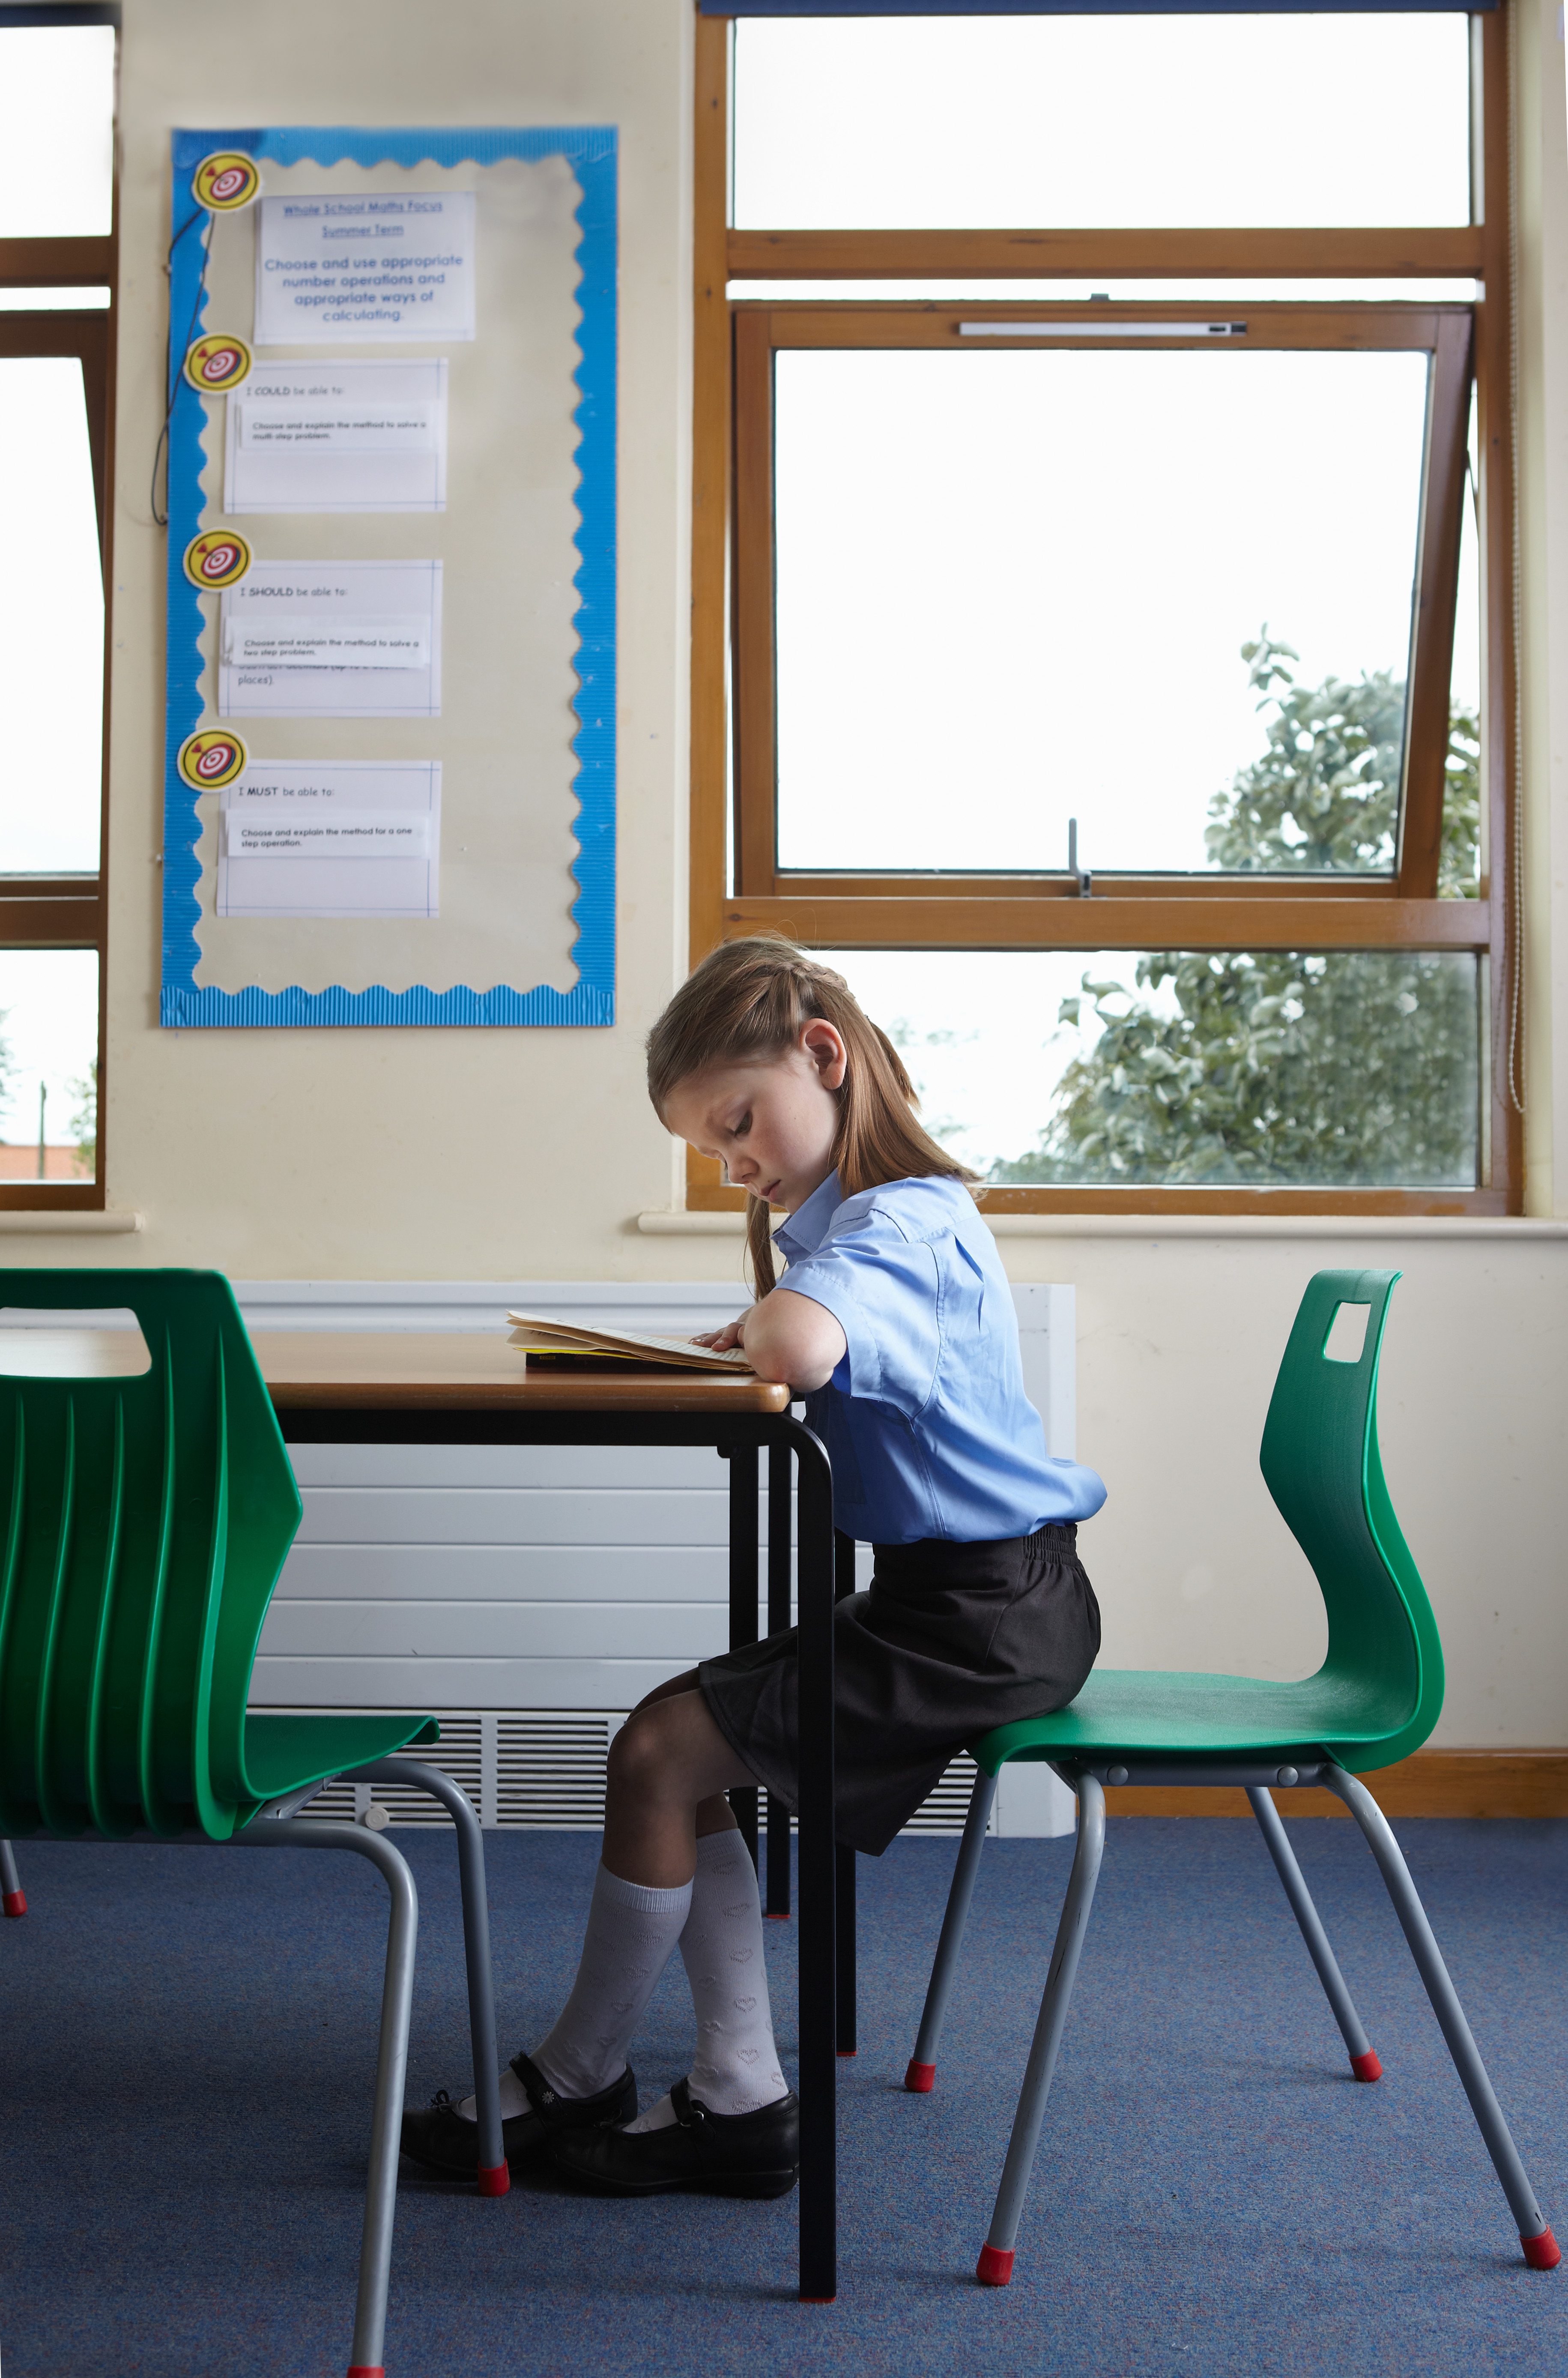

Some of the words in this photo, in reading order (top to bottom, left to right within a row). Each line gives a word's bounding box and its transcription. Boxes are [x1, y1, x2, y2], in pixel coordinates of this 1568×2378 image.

[284, 204, 320, 214] Whole
[325, 201, 364, 213] School
[368, 201, 403, 212] Maths
[408, 200, 442, 211] Focus
[323, 225, 370, 237] Summer
[375, 224, 403, 235] Term
[265, 258, 317, 271] Choose
[322, 257, 349, 269] and
[354, 258, 376, 269] use
[381, 254, 463, 269] appropriate
[283, 276, 335, 288] number
[340, 273, 413, 288] operations
[418, 272, 445, 284] and
[294, 292, 376, 307] appropriate
[381, 293, 415, 303] ways
[421, 290, 433, 302] of
[247, 387, 251, 395] I
[254, 387, 290, 395] COULD
[293, 387, 305, 395] be
[308, 386, 328, 395] able
[305, 422, 334, 430] explain
[241, 588, 245, 596] I
[249, 587, 293, 596] SHOULD
[296, 588, 308, 596] be
[311, 587, 331, 596] able
[296, 639, 327, 647] explain
[239, 787, 243, 796] I
[248, 787, 278, 796] MUST
[283, 787, 294, 796] be
[298, 787, 318, 796] able
[293, 828, 324, 838] explain
[241, 839, 258, 847] step
[261, 839, 302, 847] operation.
